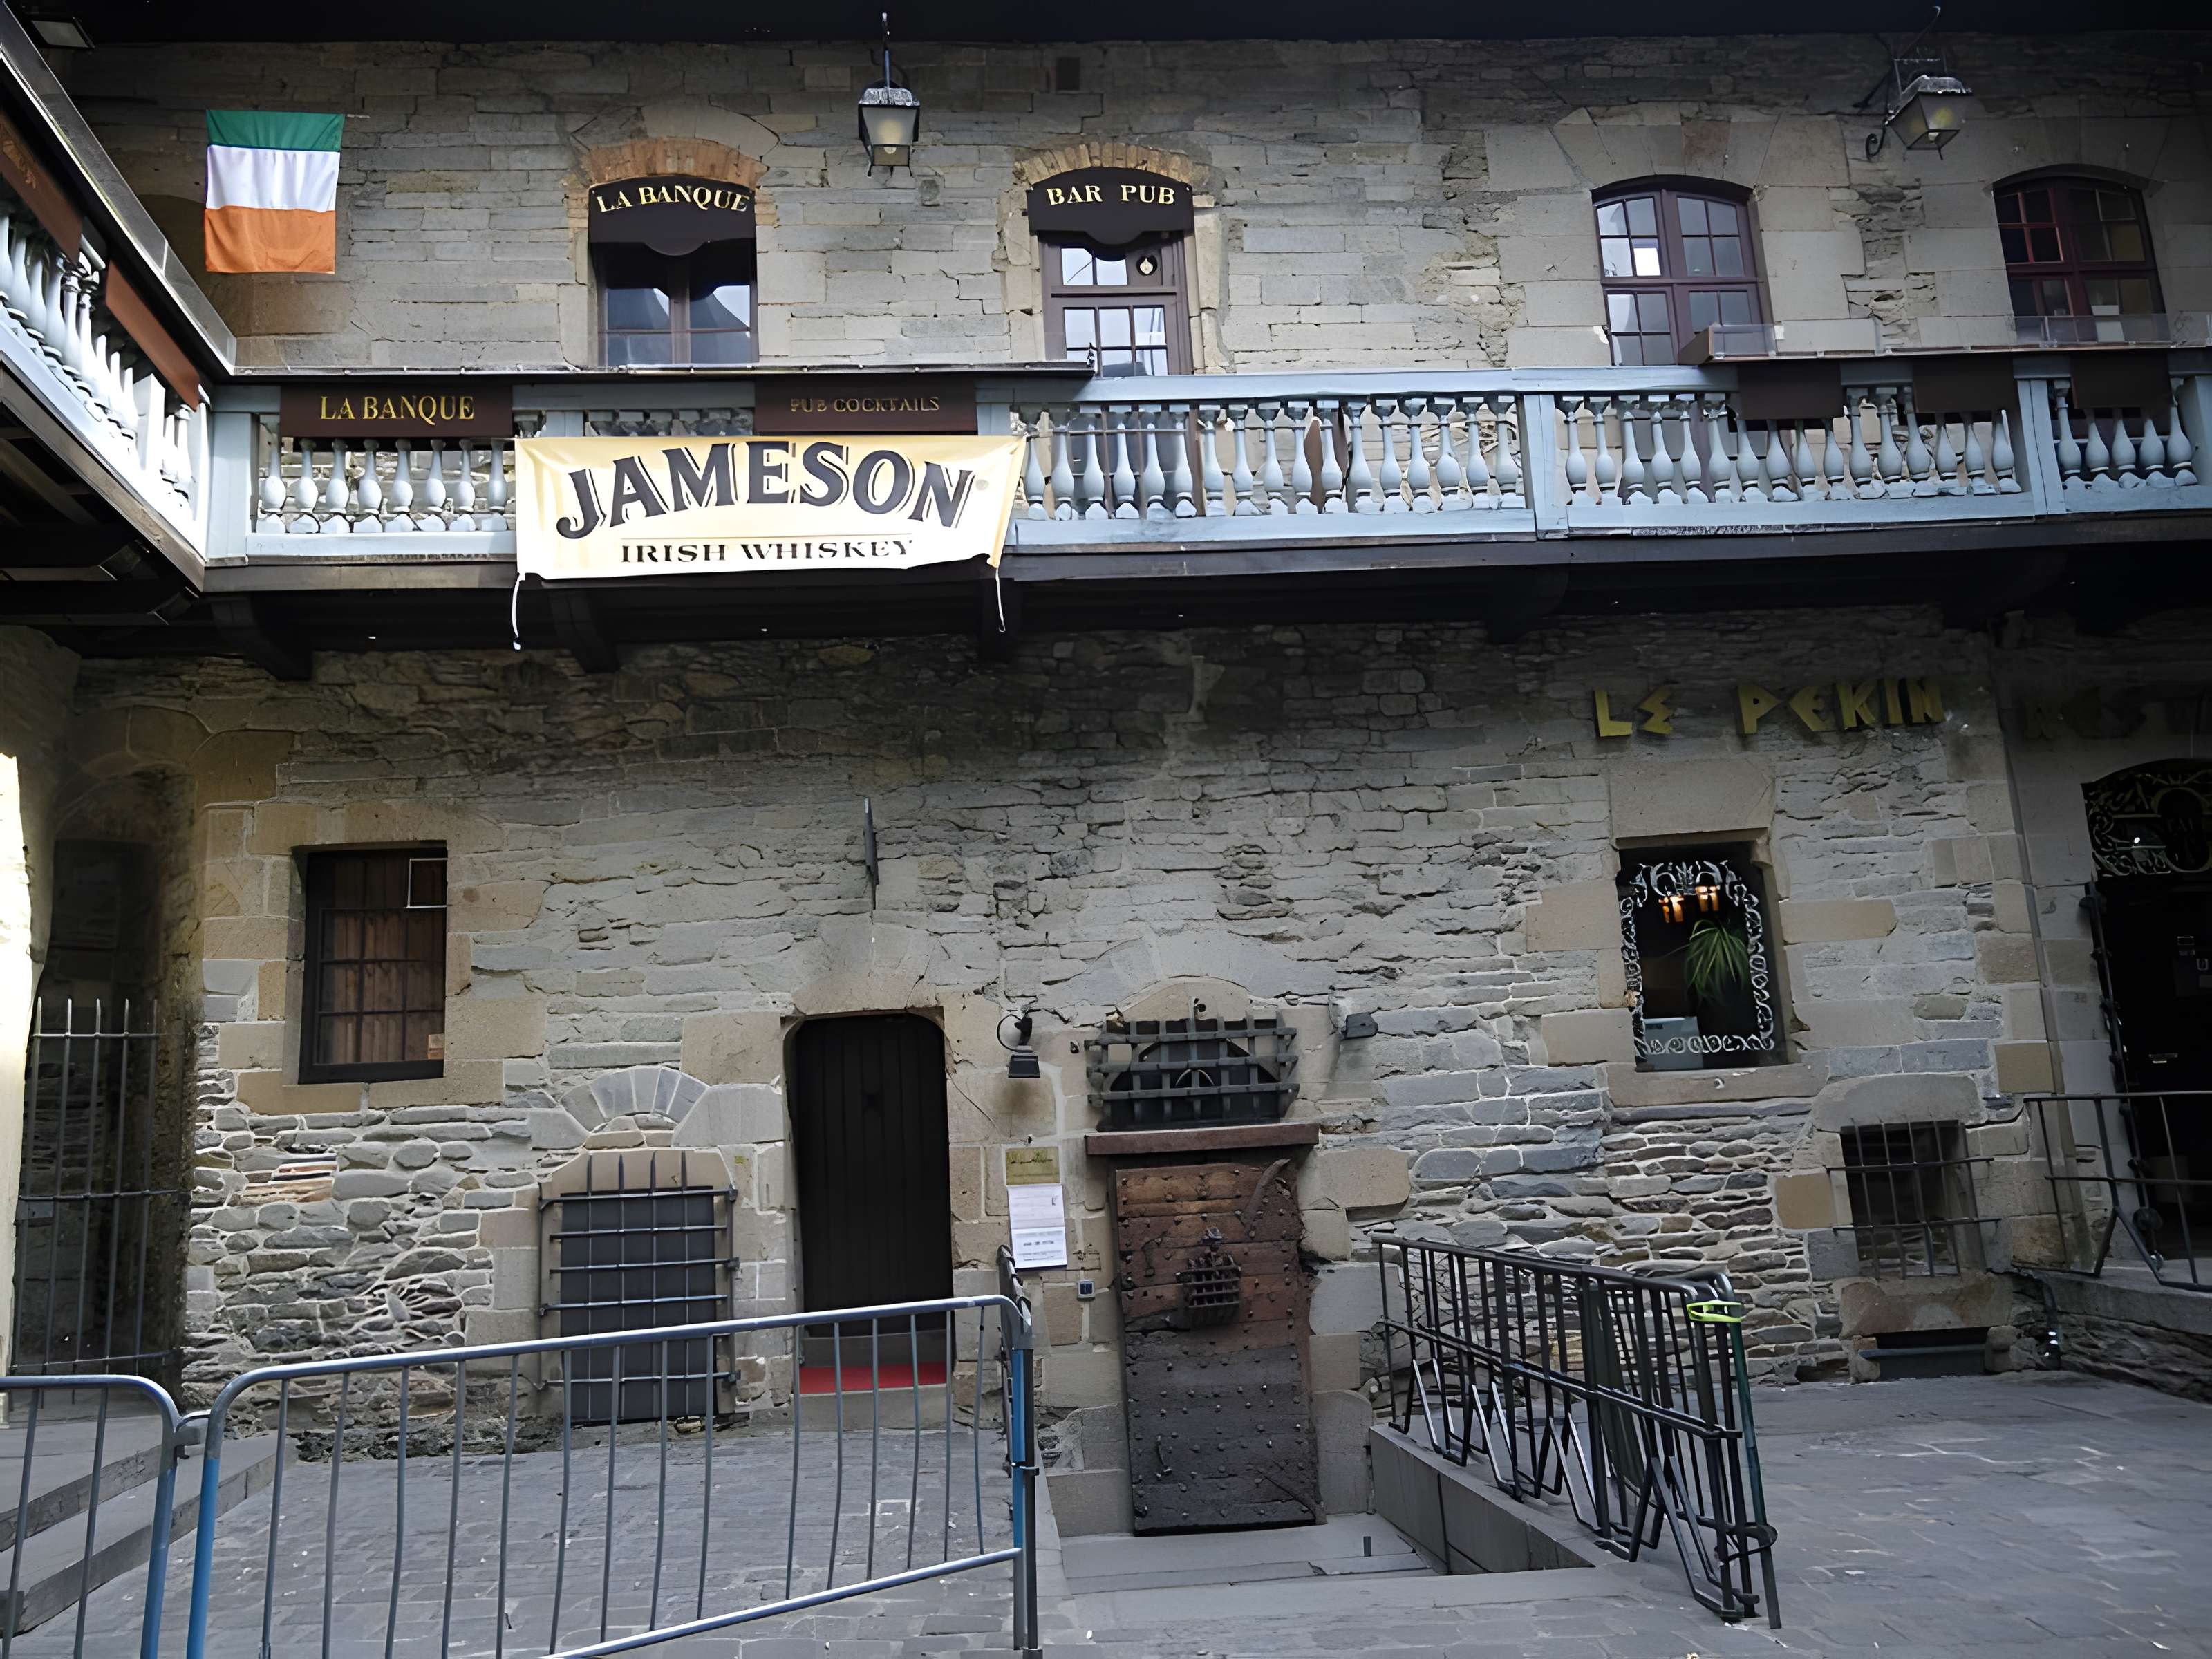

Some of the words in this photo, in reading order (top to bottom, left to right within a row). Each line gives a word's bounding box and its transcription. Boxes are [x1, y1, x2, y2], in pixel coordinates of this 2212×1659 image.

[597, 191, 633, 213] LA
[638, 185, 751, 212] BANQUE
[1047, 185, 1103, 206] BAR
[1121, 184, 1176, 205] PUB
[320, 395, 355, 420] LA
[362, 395, 475, 426] BANQUE
[790, 397, 827, 413] PUB
[834, 396, 940, 413] COCKTAILS
[556, 440, 977, 540] JAMESON
[621, 543, 728, 563] IRISH
[740, 538, 915, 561] WHISKEY
[1593, 686, 1676, 738] LE
[1737, 677, 1947, 735] PEKIN
